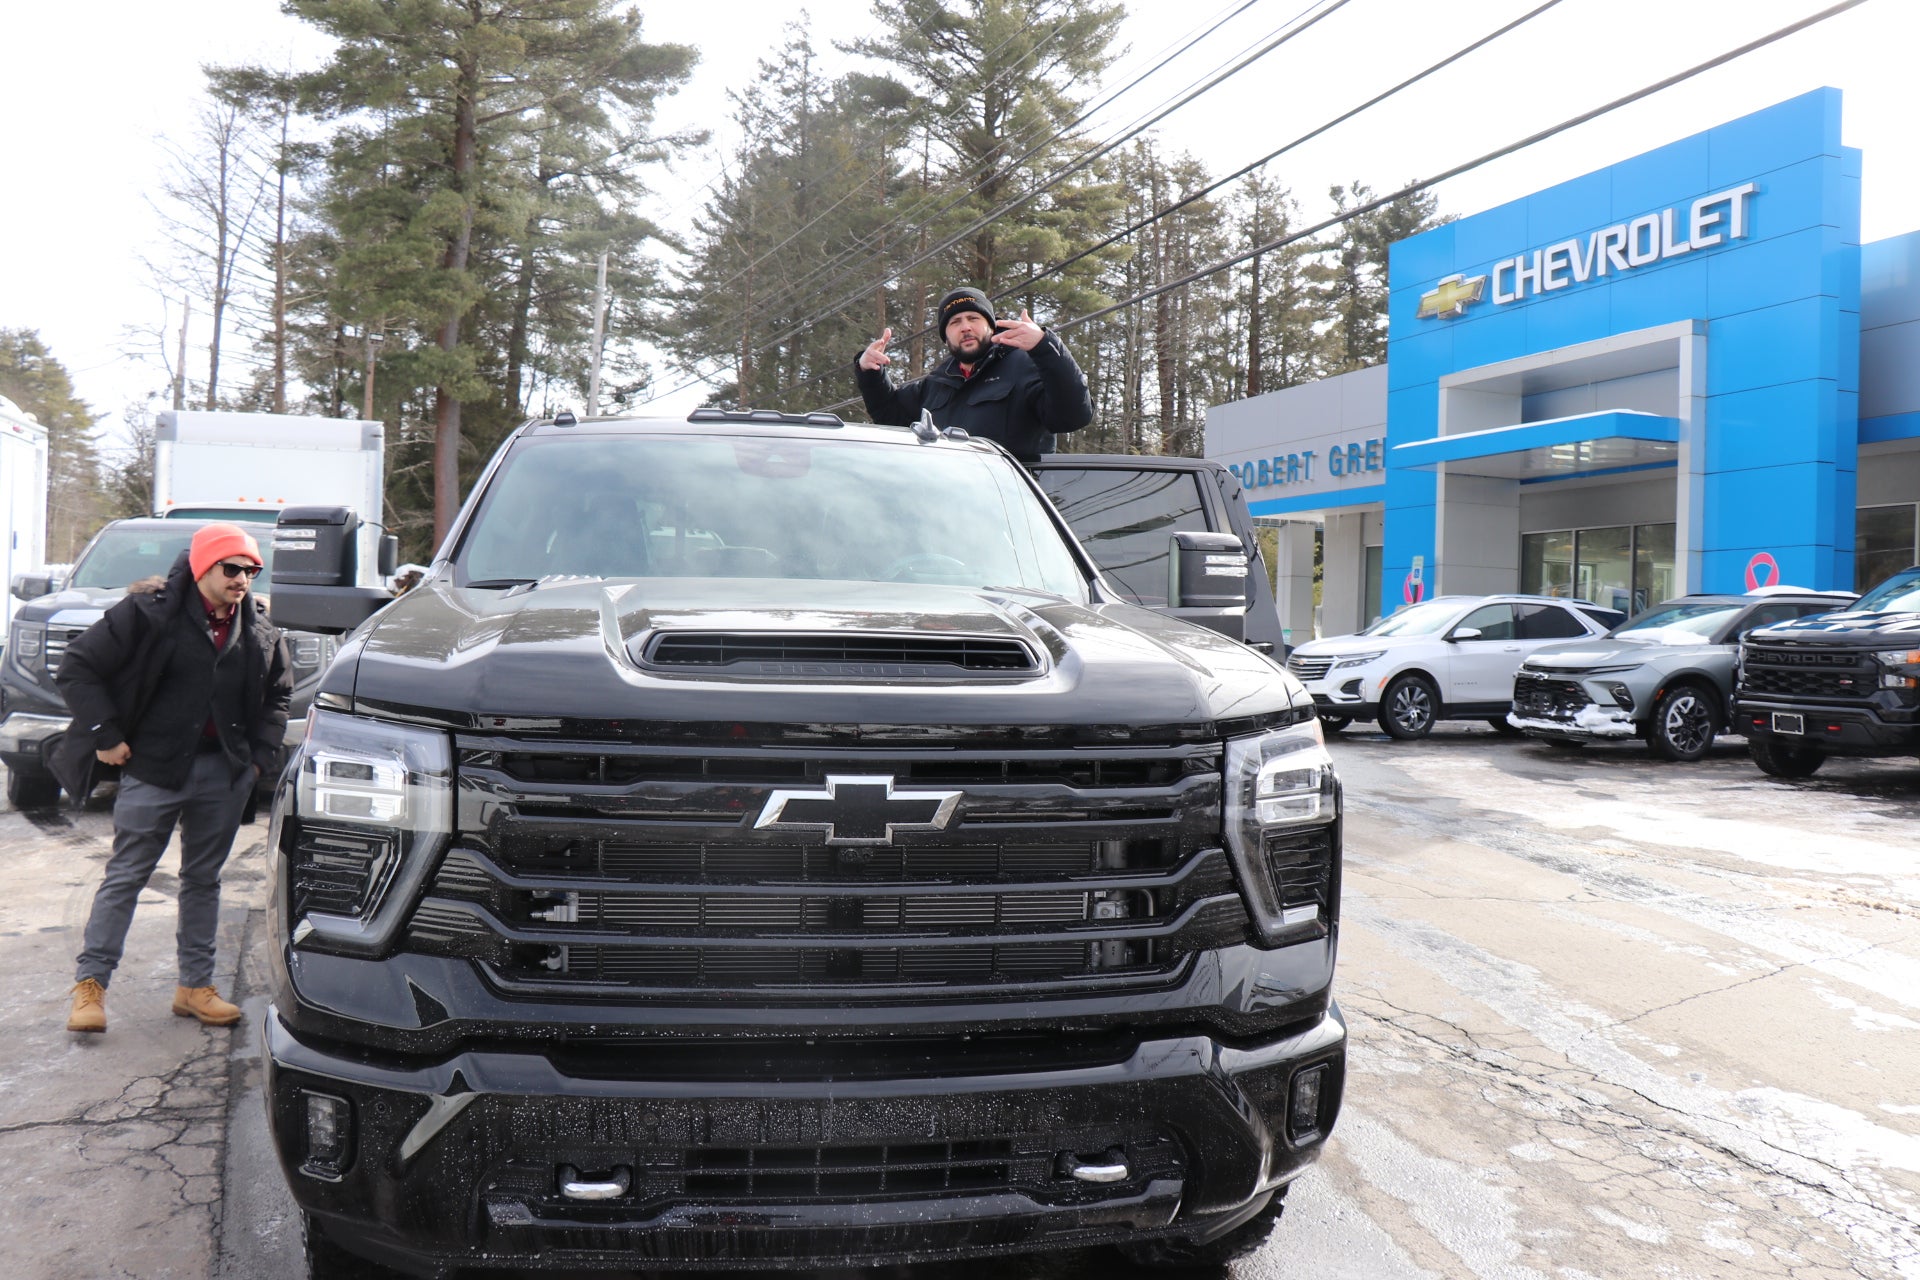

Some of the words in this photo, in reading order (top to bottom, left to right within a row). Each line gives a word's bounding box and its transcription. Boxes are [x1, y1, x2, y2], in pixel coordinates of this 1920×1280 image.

[1492, 182, 1756, 304] CHEVROLET
[1329, 437, 1387, 477] GRE
[759, 664, 931, 675] CHEVROLET
[1746, 650, 1860, 665] CHEVROLET
